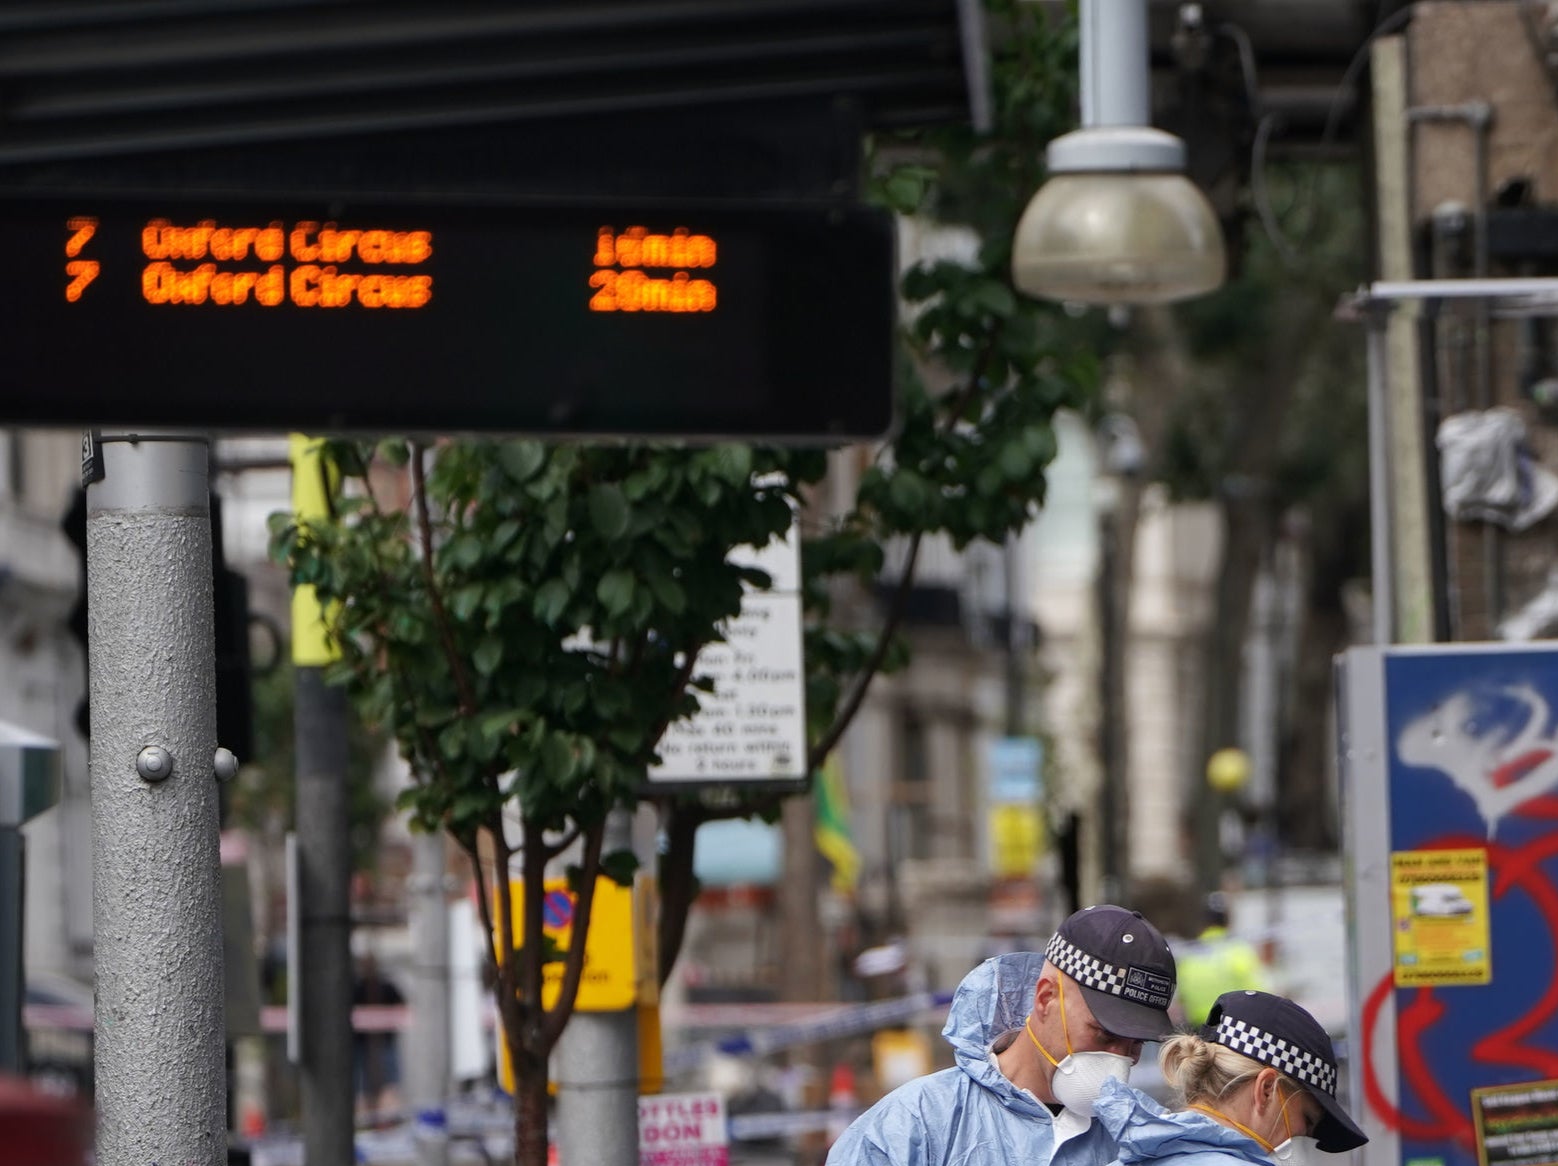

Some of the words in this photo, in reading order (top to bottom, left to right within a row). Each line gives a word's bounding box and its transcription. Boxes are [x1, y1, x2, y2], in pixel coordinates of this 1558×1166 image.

[66, 216, 99, 258] 7
[142, 219, 284, 260] Oxford
[290, 221, 431, 263] Circus
[66, 261, 99, 302] 7
[142, 262, 284, 306] Oxford
[290, 265, 431, 308] Circus
[1124, 987, 1149, 1001] POLICE
